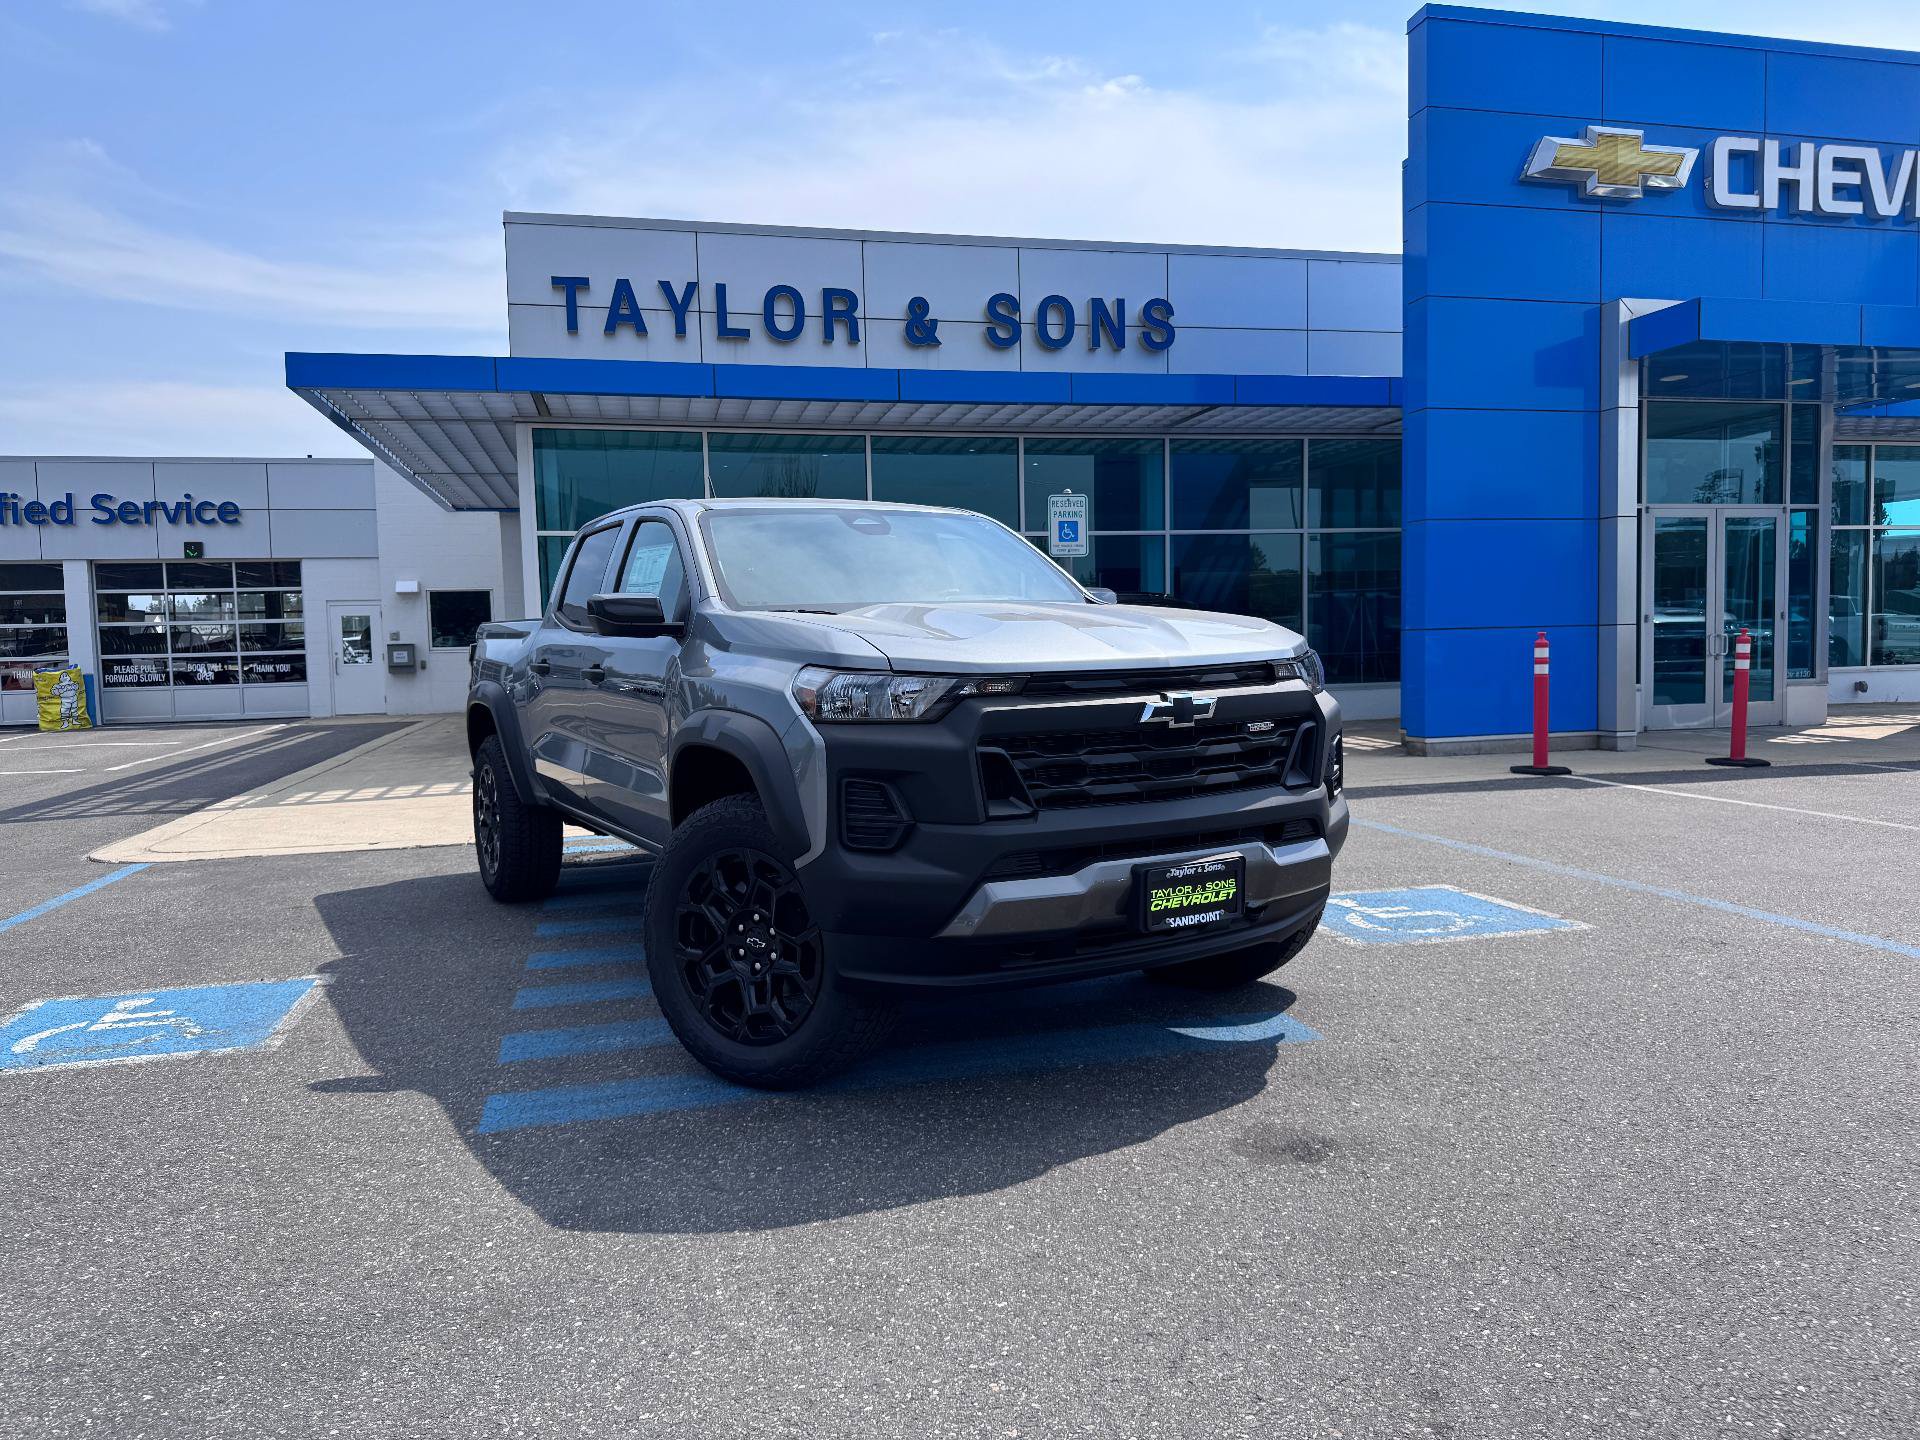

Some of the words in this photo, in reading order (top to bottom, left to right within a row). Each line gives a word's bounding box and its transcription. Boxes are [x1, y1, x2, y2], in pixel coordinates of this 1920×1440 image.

[1705, 136, 1920, 220] CHEV
[551, 276, 861, 344] TAYLOR
[905, 296, 942, 346] &
[984, 292, 1176, 350] SONS
[90, 493, 241, 526] Service
[1051, 499, 1084, 508] RESERVED
[1053, 510, 1083, 519] PARKING
[113, 665, 138, 674] PLEASE
[140, 664, 156, 673] PULL
[253, 664, 274, 672] THANK
[275, 663, 291, 672] YOU!
[13, 670, 33, 679] THAN
[105, 674, 137, 683] FORWARD
[139, 673, 166, 682] SLOWLY
[197, 672, 215, 680] OPEN
[1169, 865, 1195, 878] Taylor
[1204, 863, 1222, 873] Sons
[1150, 885, 1192, 899] TAYLOR
[1195, 884, 1203, 894] &
[1205, 878, 1236, 891] SONS
[1150, 888, 1237, 912] CHEVROLET
[1169, 911, 1220, 928] SANDPOINT
